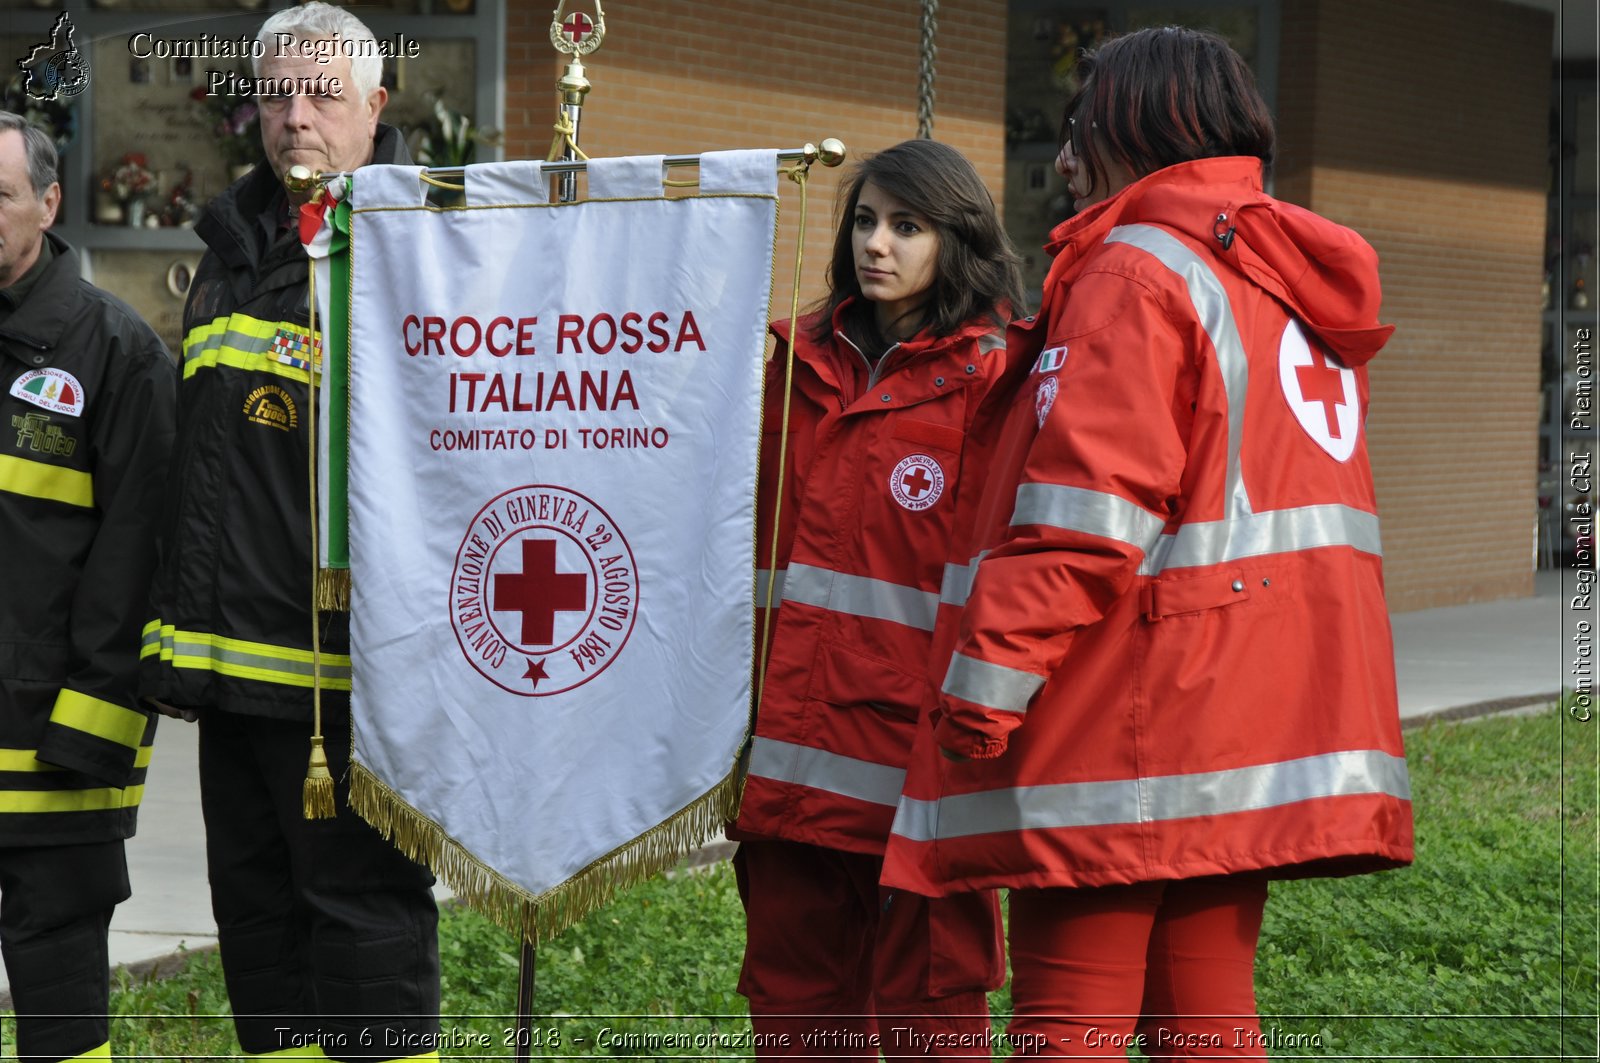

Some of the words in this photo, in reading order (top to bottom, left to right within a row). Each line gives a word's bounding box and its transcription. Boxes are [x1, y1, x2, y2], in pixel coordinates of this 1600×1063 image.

[402, 314, 538, 358] CROCE
[556, 310, 707, 354] ROSSA
[39, 399, 51, 409] DEL
[53, 403, 76, 413] FUOCO
[449, 369, 640, 413] ITALIANA
[430, 428, 536, 451] COMITATO
[544, 428, 567, 449] DI
[578, 426, 669, 449] TORINO
[909, 456, 934, 468] GINEVRA
[932, 466, 941, 475] 22
[892, 464, 908, 505] CONVENZIONE
[928, 475, 943, 503] AGOSTO
[481, 509, 507, 541] DI
[506, 494, 589, 534] GINEVRA
[585, 523, 613, 552] 22
[457, 533, 507, 669] CONVENZIONE
[598, 554, 631, 631] AGOSTO
[569, 630, 612, 672] 1864
